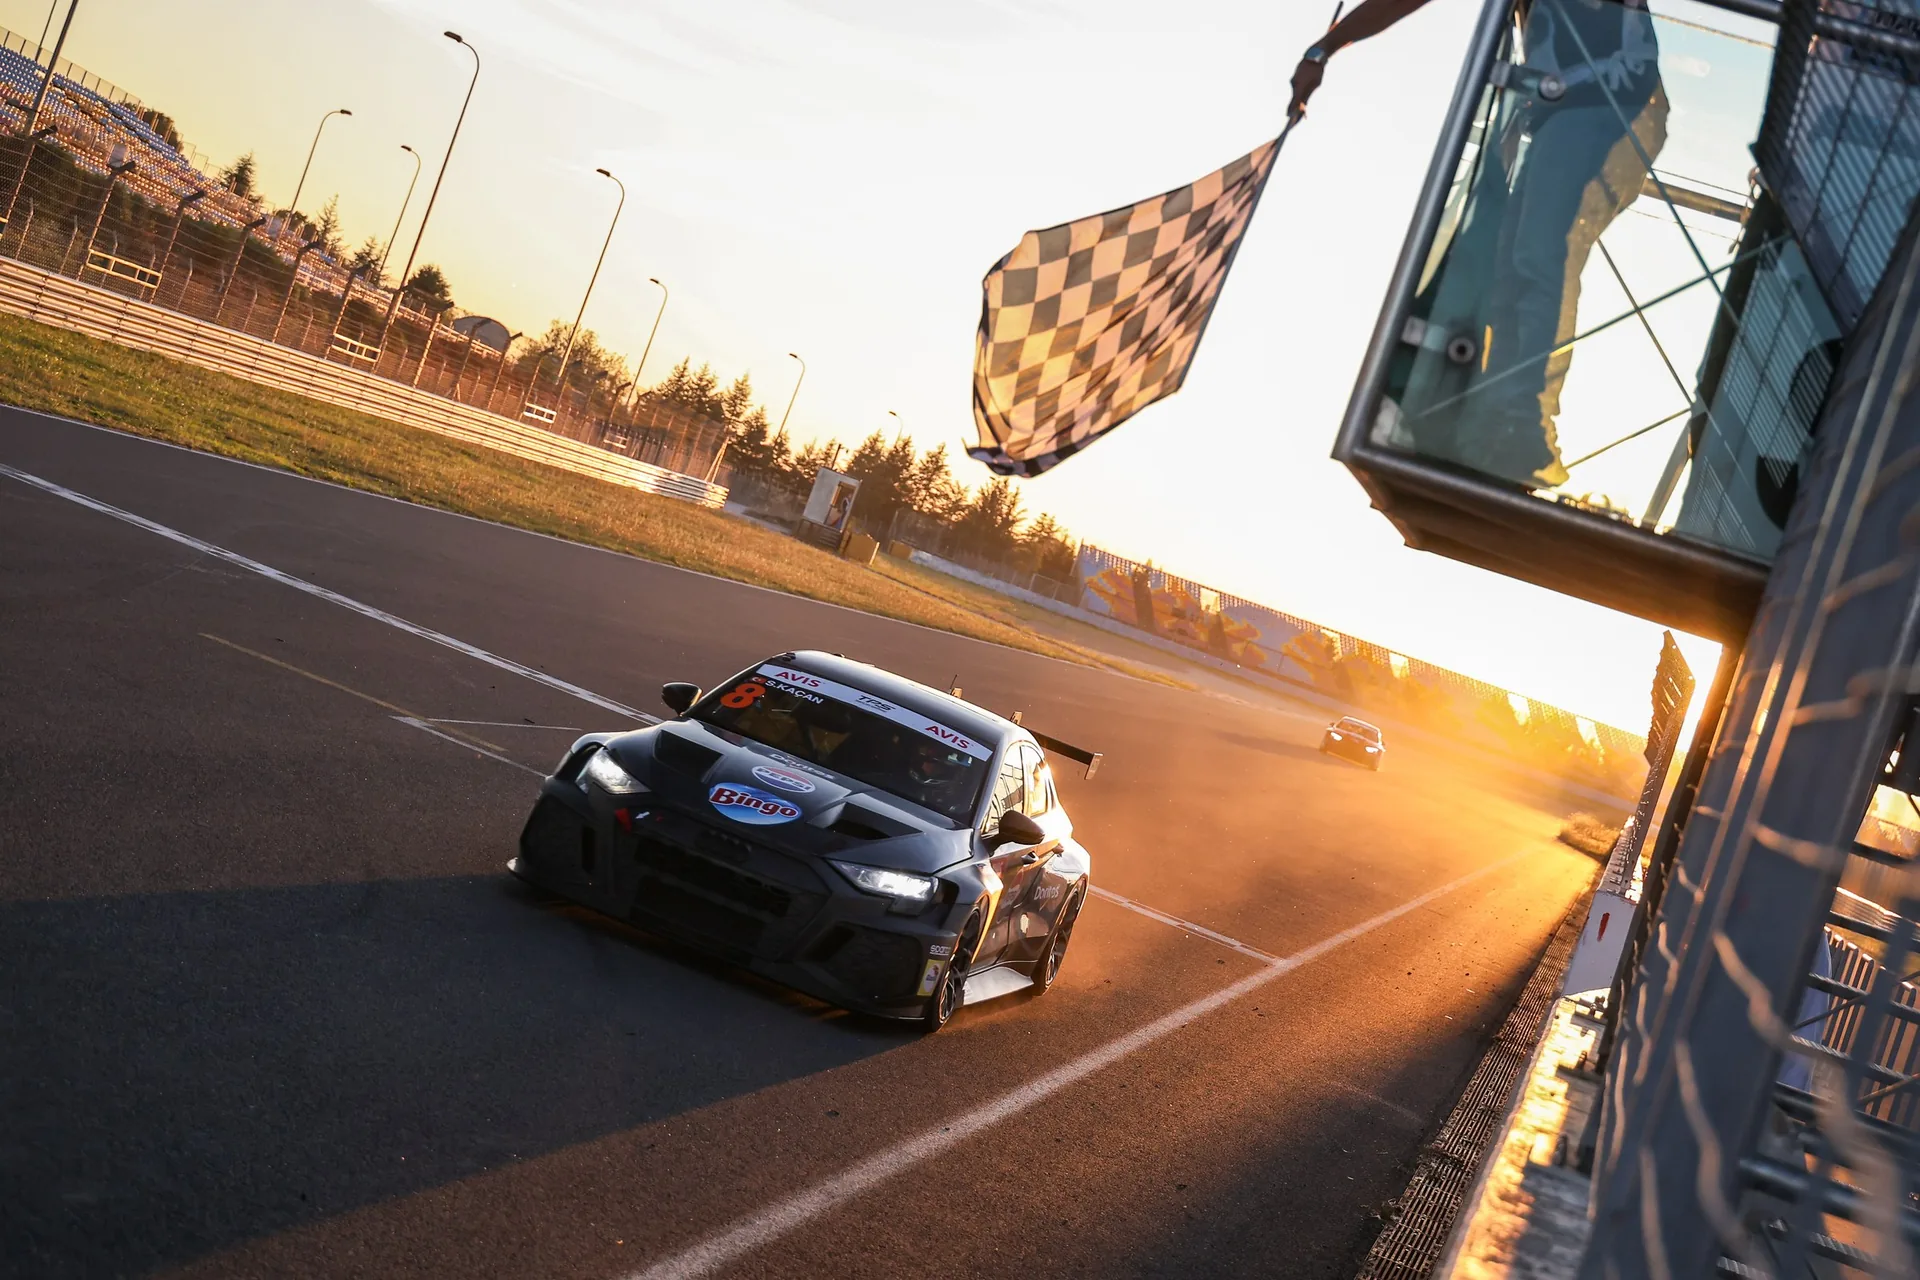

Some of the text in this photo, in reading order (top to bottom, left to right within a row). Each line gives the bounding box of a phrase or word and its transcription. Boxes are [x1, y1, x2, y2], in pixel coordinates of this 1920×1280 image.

[775, 671, 822, 688] AVIS
[720, 682, 766, 709] 8
[765, 680, 824, 705] S.KAÇAN
[924, 725, 970, 749] AVIS
[755, 767, 812, 791] PEPSI
[709, 786, 799, 818] Bingo
